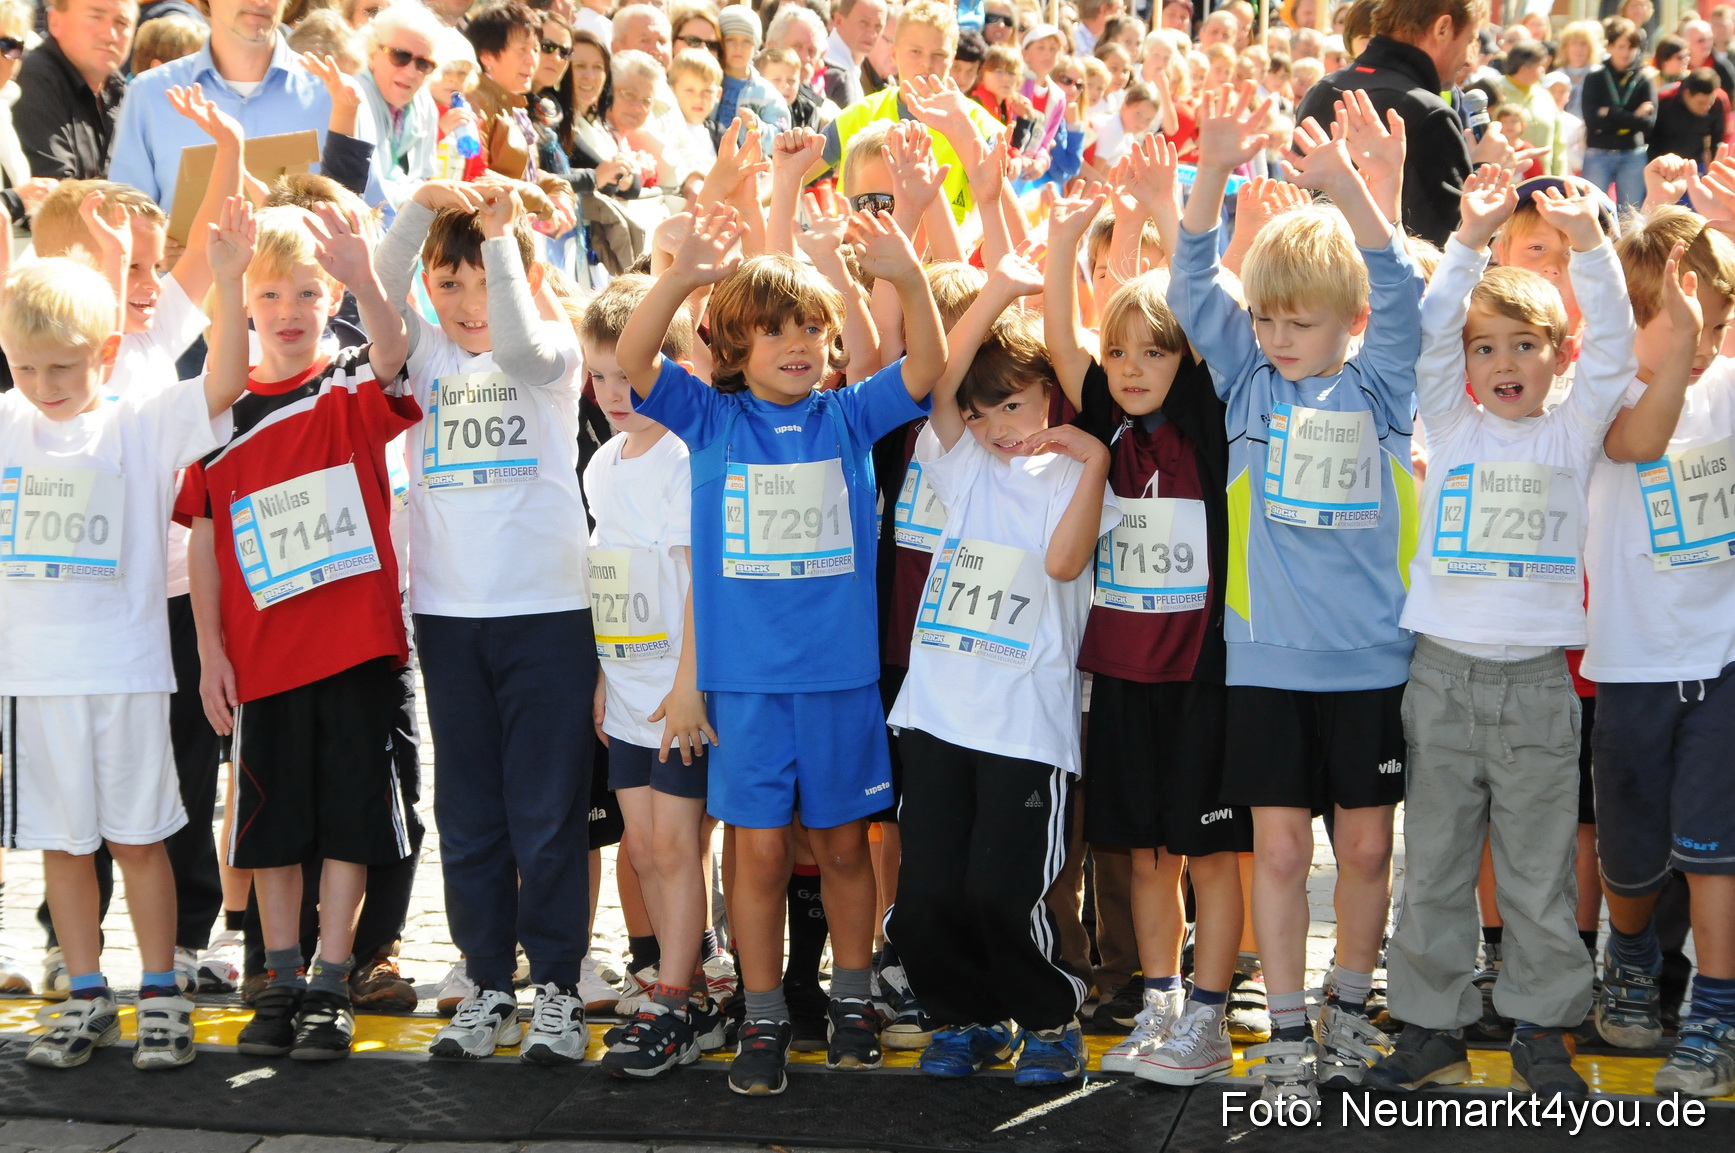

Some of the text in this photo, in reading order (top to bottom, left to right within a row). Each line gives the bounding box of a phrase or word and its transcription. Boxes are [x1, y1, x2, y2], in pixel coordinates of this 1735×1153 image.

[441, 383, 517, 406] Korbinian
[443, 415, 527, 450] 7062
[1296, 416, 1360, 443] Michael
[488, 466, 538, 478] PFLEIDERER
[1294, 453, 1371, 489] 7151
[1680, 455, 1727, 481] Lukas
[25, 475, 74, 497] Quirin
[754, 473, 796, 495] Felix
[1480, 470, 1542, 494] Matteo
[258, 490, 311, 519] Niklas
[727, 506, 741, 522] K2
[1444, 505, 1462, 521] K2
[1652, 499, 1671, 518] K2
[24, 510, 109, 545] 7060
[757, 504, 839, 540] 7291
[1480, 507, 1568, 541] 7297
[270, 507, 357, 560] 7144
[239, 538, 256, 557] K2
[955, 546, 984, 570] Finn
[1116, 541, 1194, 574] 7139
[61, 564, 116, 577] PFLEIDERER
[323, 554, 376, 575] PFLEIDERER
[735, 564, 769, 572] BOCK
[806, 555, 851, 569] PFLEIDERER
[1525, 563, 1576, 575] PFLEIDERER
[930, 577, 942, 593] K2
[592, 592, 649, 623] 7270
[947, 581, 1030, 625] 7117
[625, 639, 670, 653] PFLEIDERER
[974, 639, 1027, 661] PFLEIDERER
[1201, 808, 1232, 824] cawi
